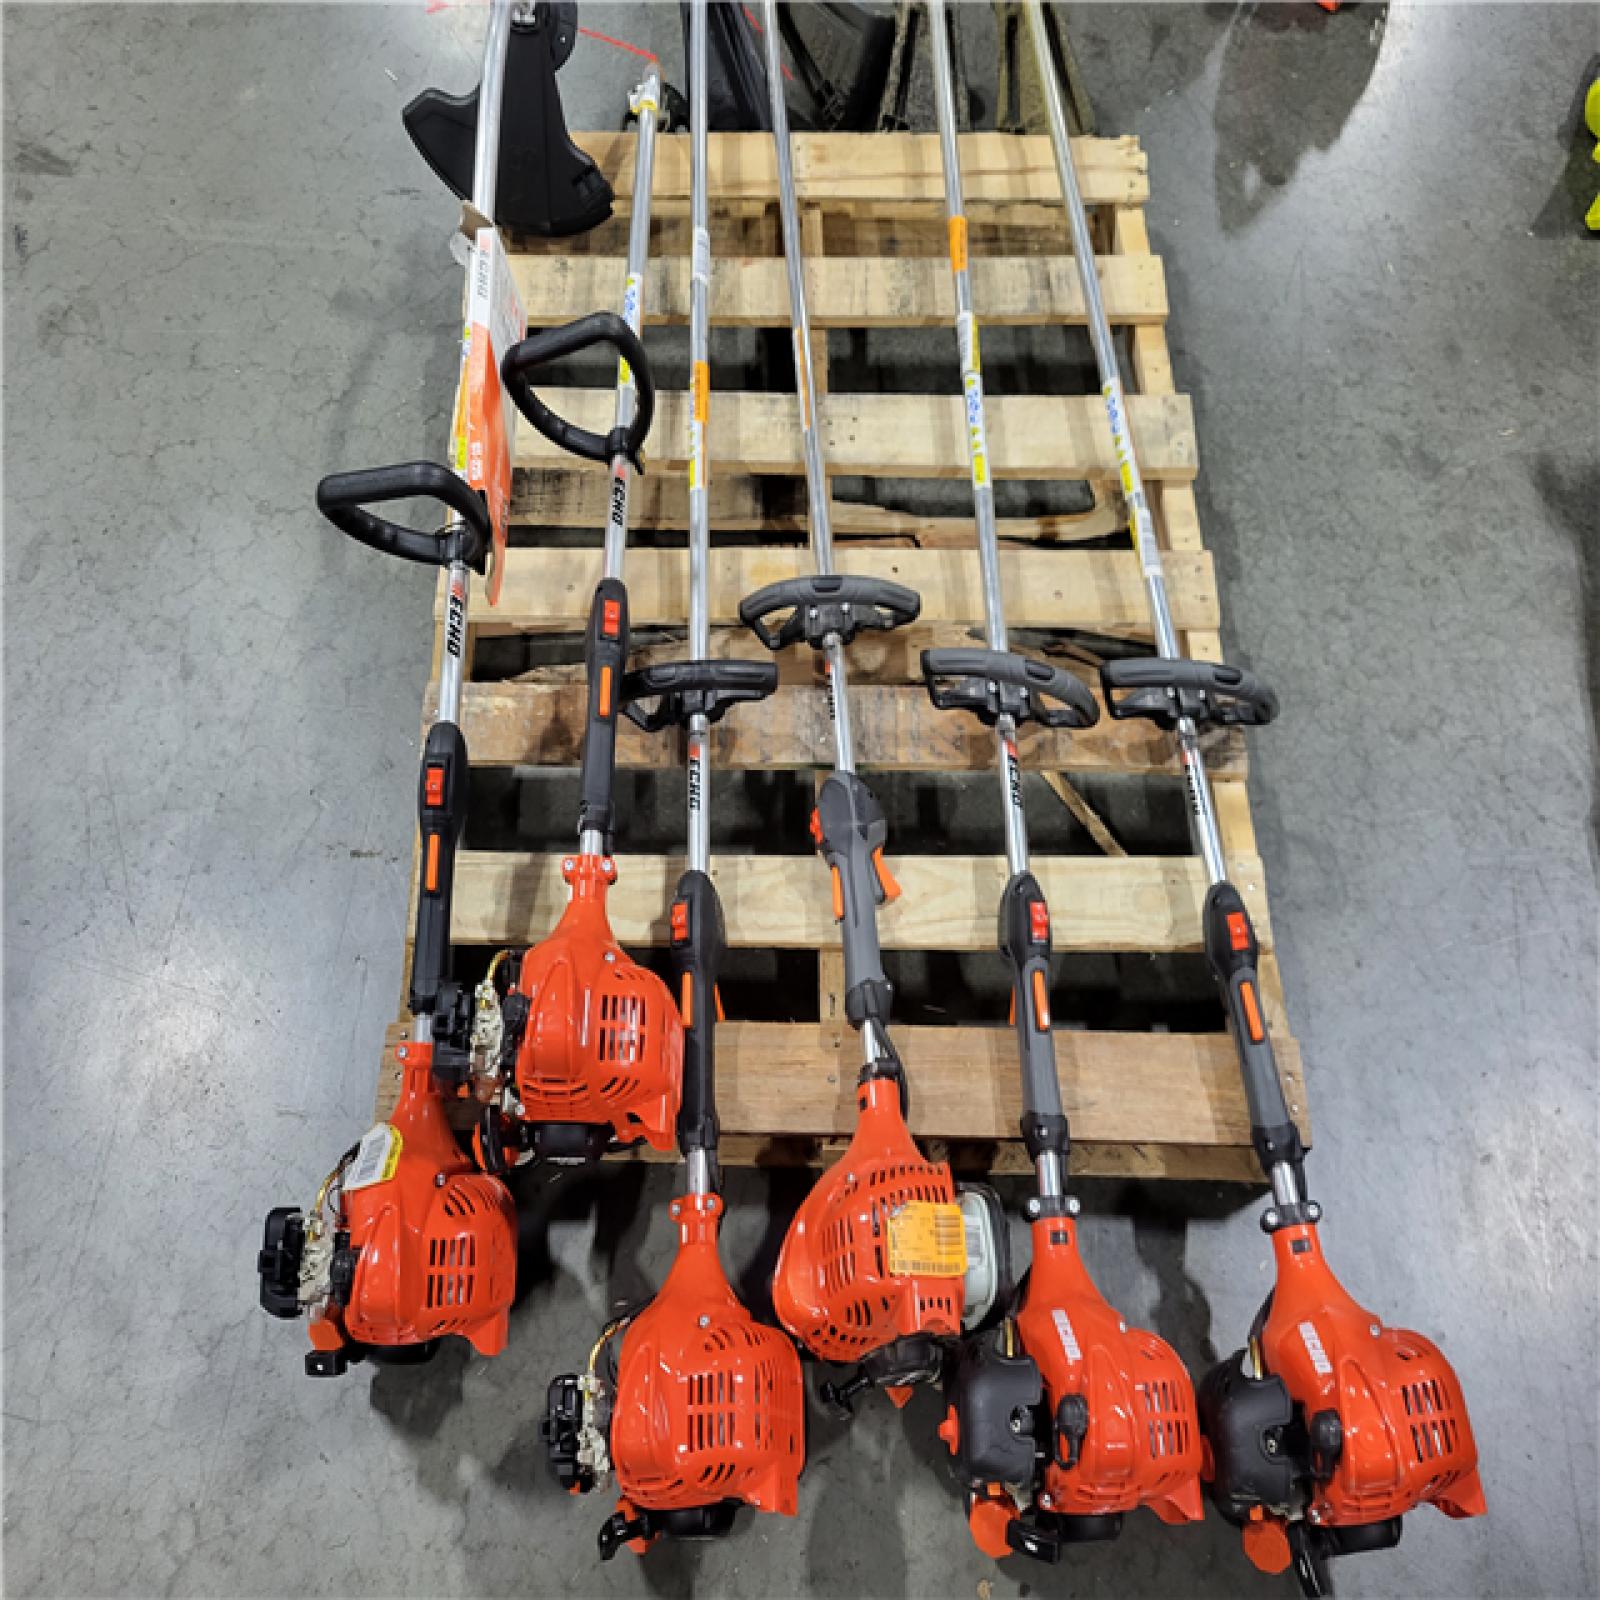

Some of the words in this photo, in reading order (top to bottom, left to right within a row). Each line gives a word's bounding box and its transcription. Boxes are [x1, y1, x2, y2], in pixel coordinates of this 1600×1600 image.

[611, 476, 625, 526] ECHO
[447, 595, 463, 657] ECHO
[689, 759, 700, 810] ECHO
